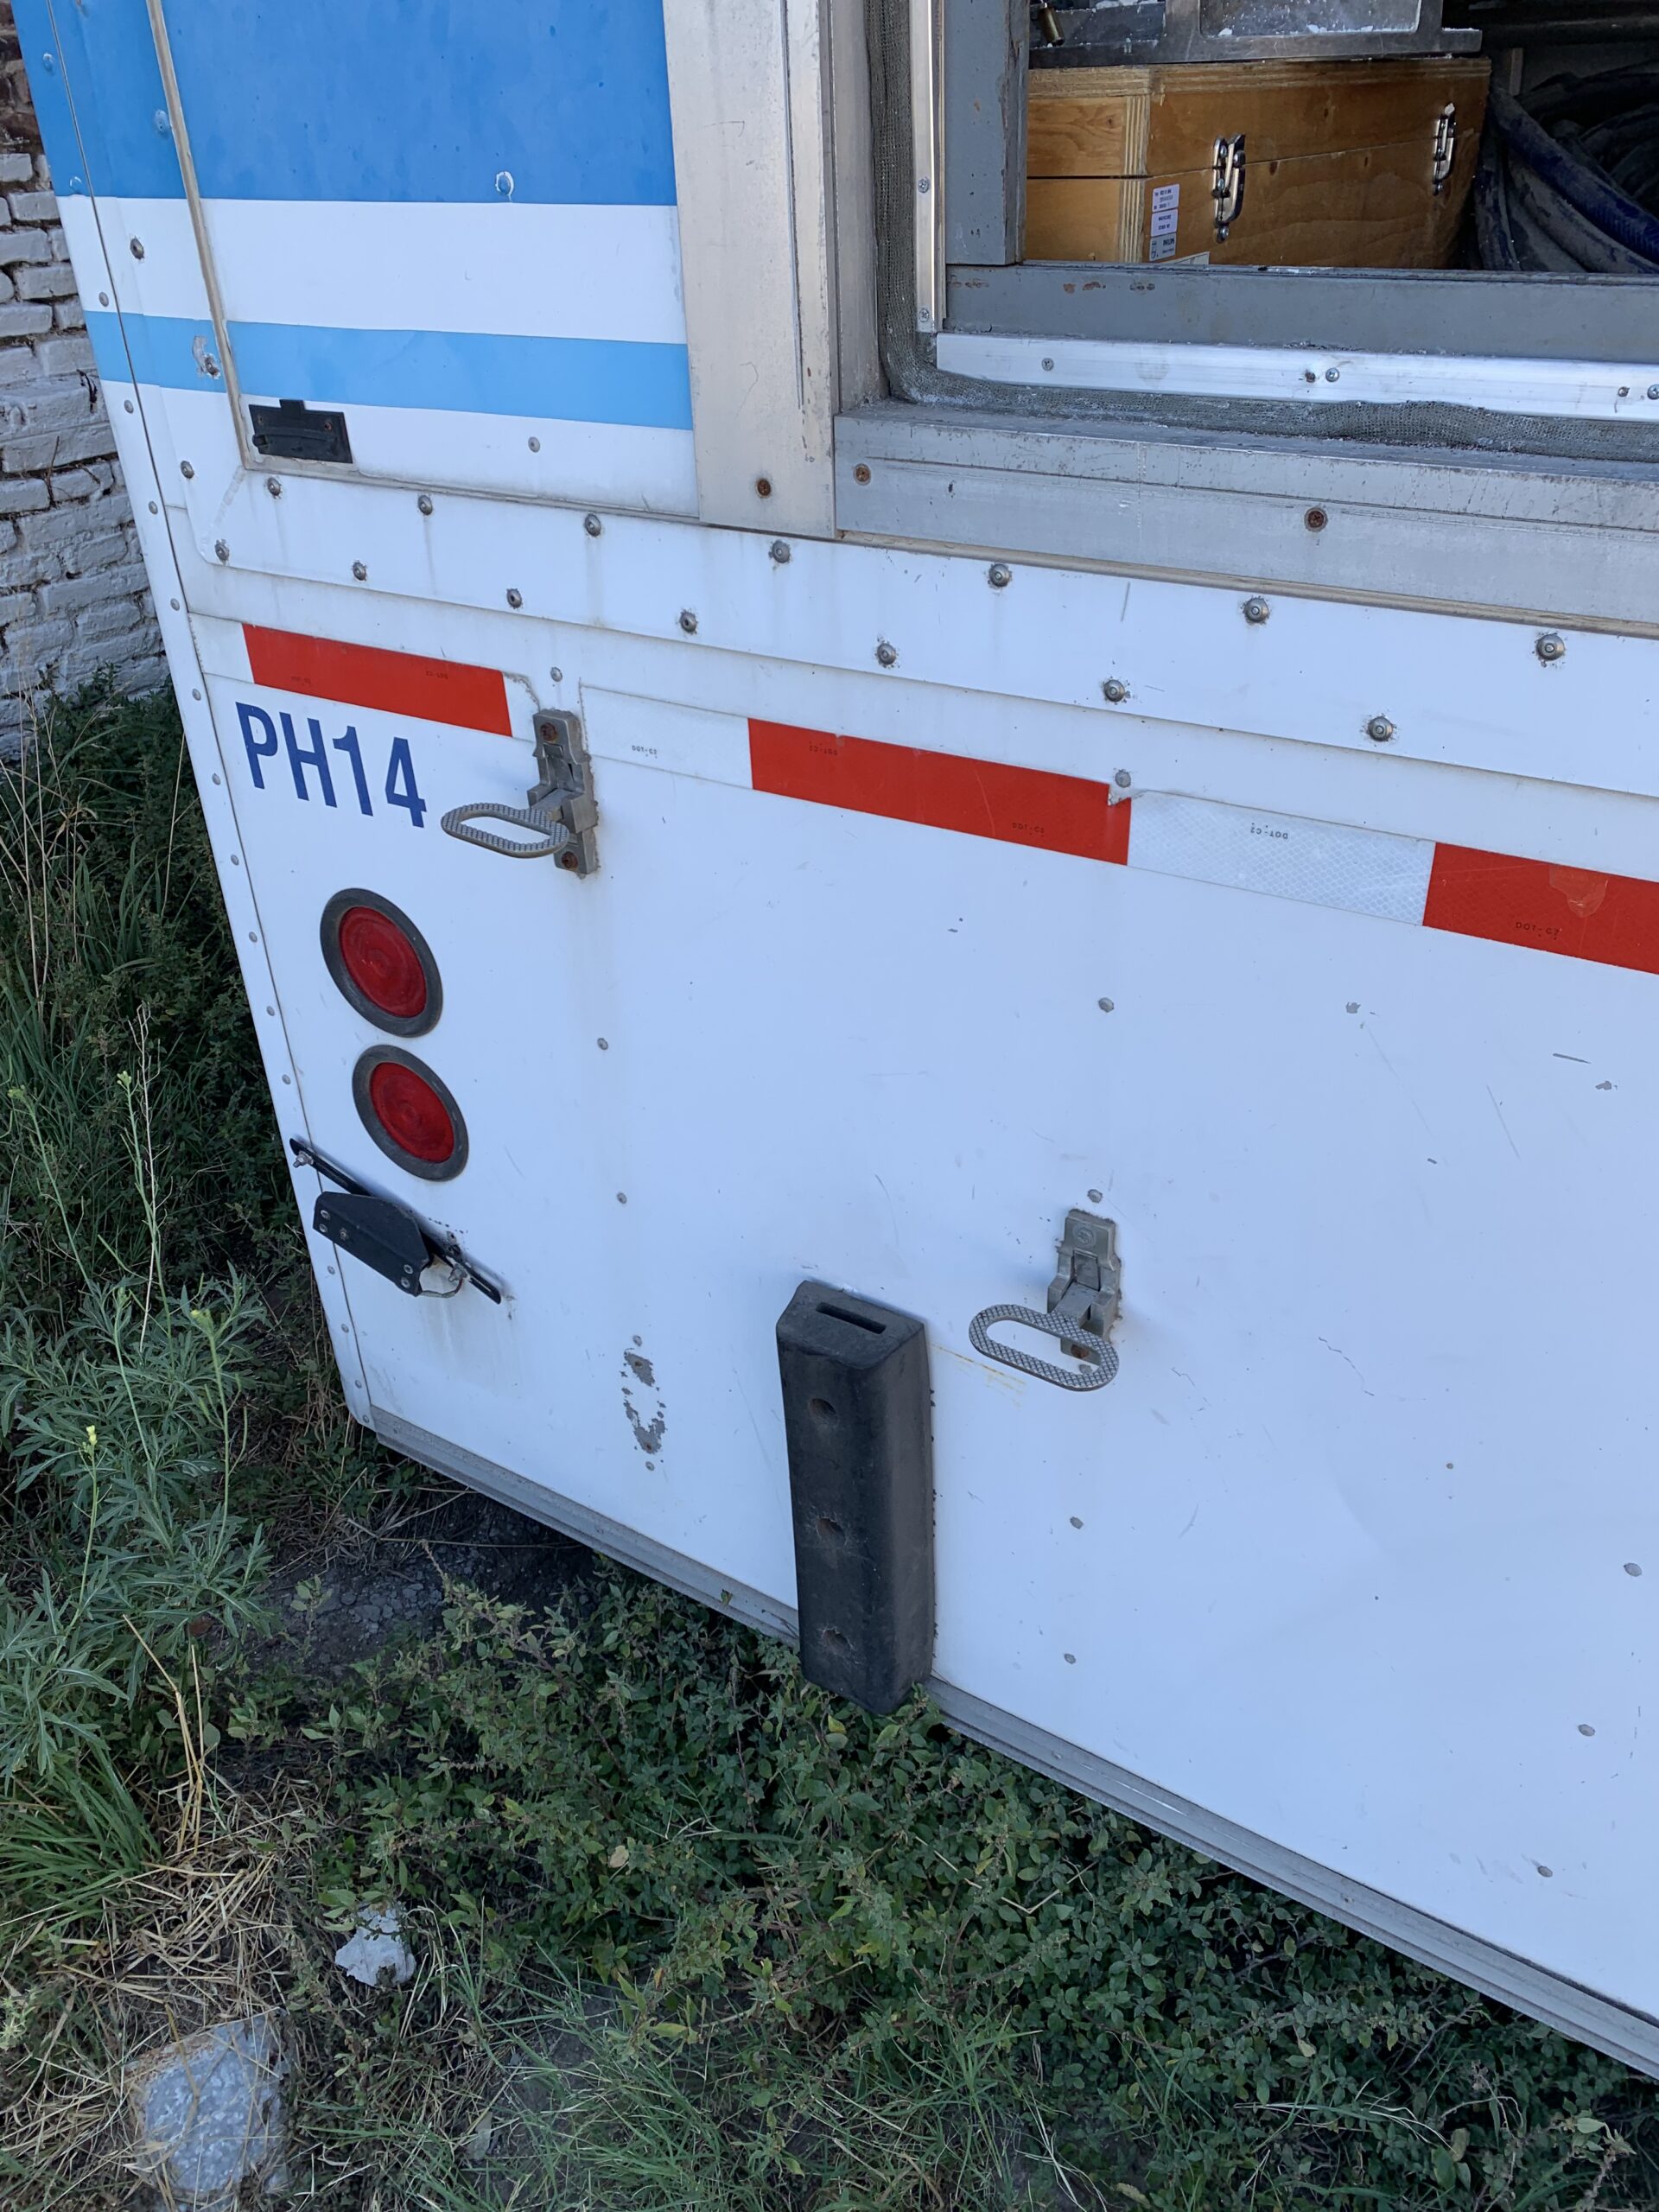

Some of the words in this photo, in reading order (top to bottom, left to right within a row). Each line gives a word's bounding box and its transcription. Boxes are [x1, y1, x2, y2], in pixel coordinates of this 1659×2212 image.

[632, 745, 657, 755] DOT-C2
[235, 702, 427, 828] PH14
[1250, 827, 1288, 840] DOT-C2
[1516, 921, 1559, 936] DOT-C2
